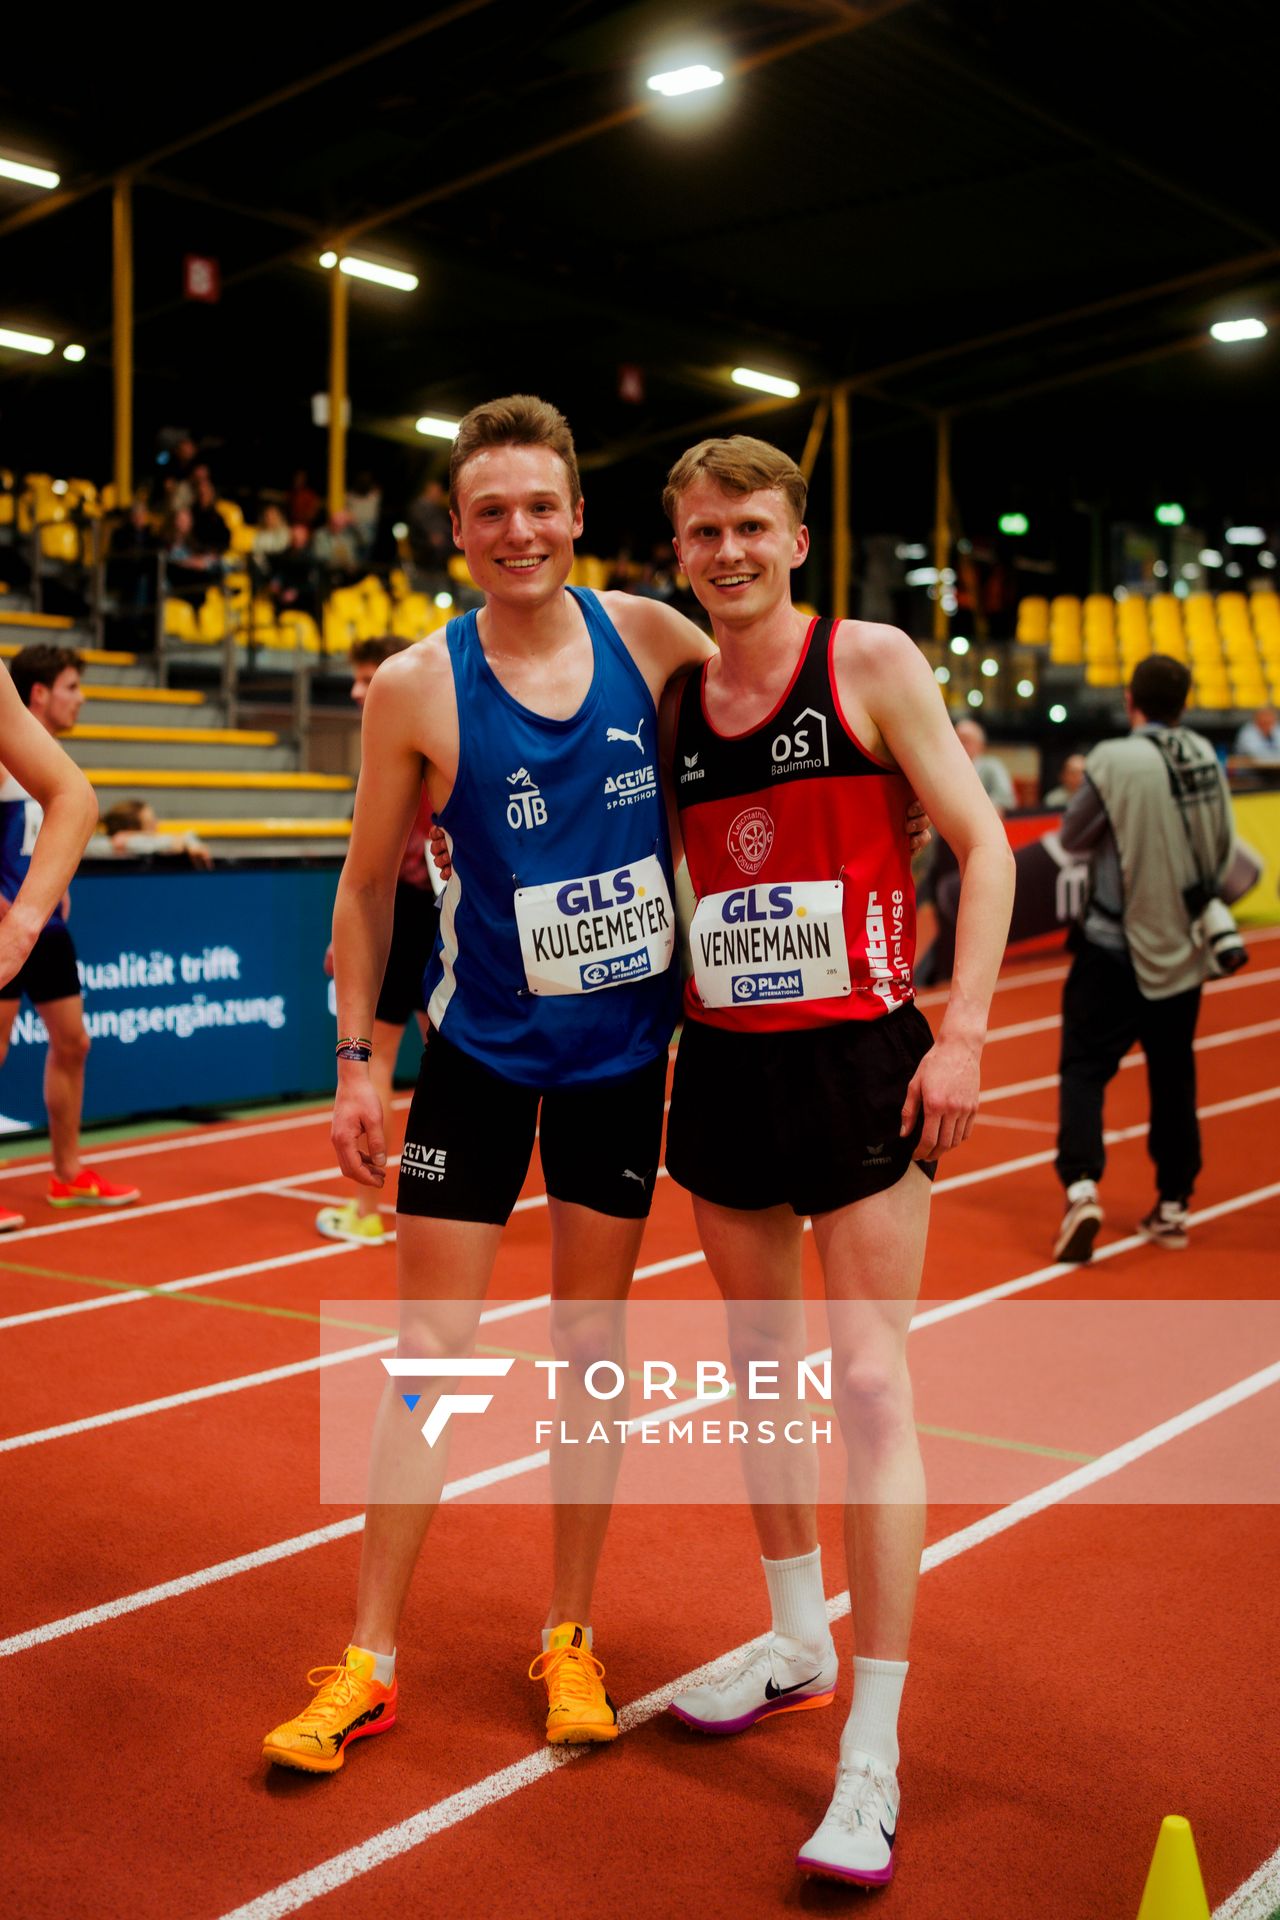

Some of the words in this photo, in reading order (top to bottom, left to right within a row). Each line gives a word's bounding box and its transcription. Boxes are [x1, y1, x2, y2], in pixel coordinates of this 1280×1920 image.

[771, 730, 810, 762] OS
[680, 769, 705, 784] erima
[506, 789, 548, 830] OTB
[531, 896, 670, 962] KULGEMEYER
[700, 922, 832, 968] VENNEMANN
[76, 951, 176, 991] ualität
[181, 945, 240, 983] trifft
[610, 953, 648, 975] PLAN
[758, 976, 800, 991] PLAN
[759, 989, 800, 997] INTERNATIONAL
